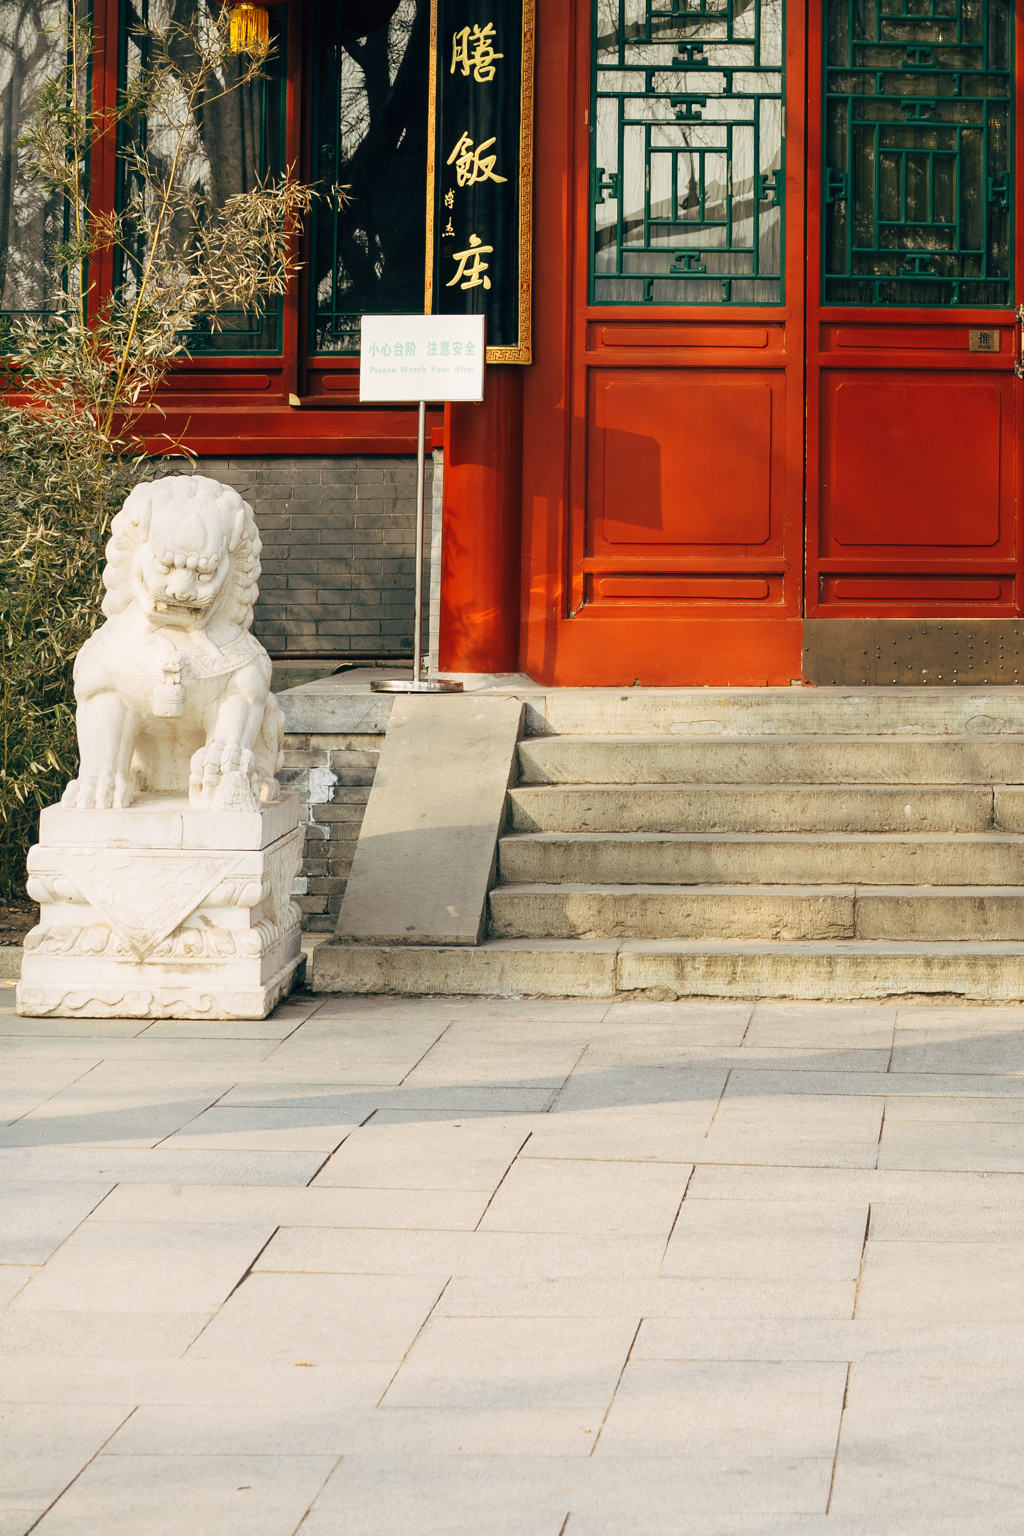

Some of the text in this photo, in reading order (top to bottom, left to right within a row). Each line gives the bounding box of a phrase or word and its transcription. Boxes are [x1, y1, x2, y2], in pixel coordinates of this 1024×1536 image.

[978, 332, 992, 344] 推
[368, 340, 476, 357] 小心台阶 注意安全
[369, 366, 474, 374] Please Watch Your Step
